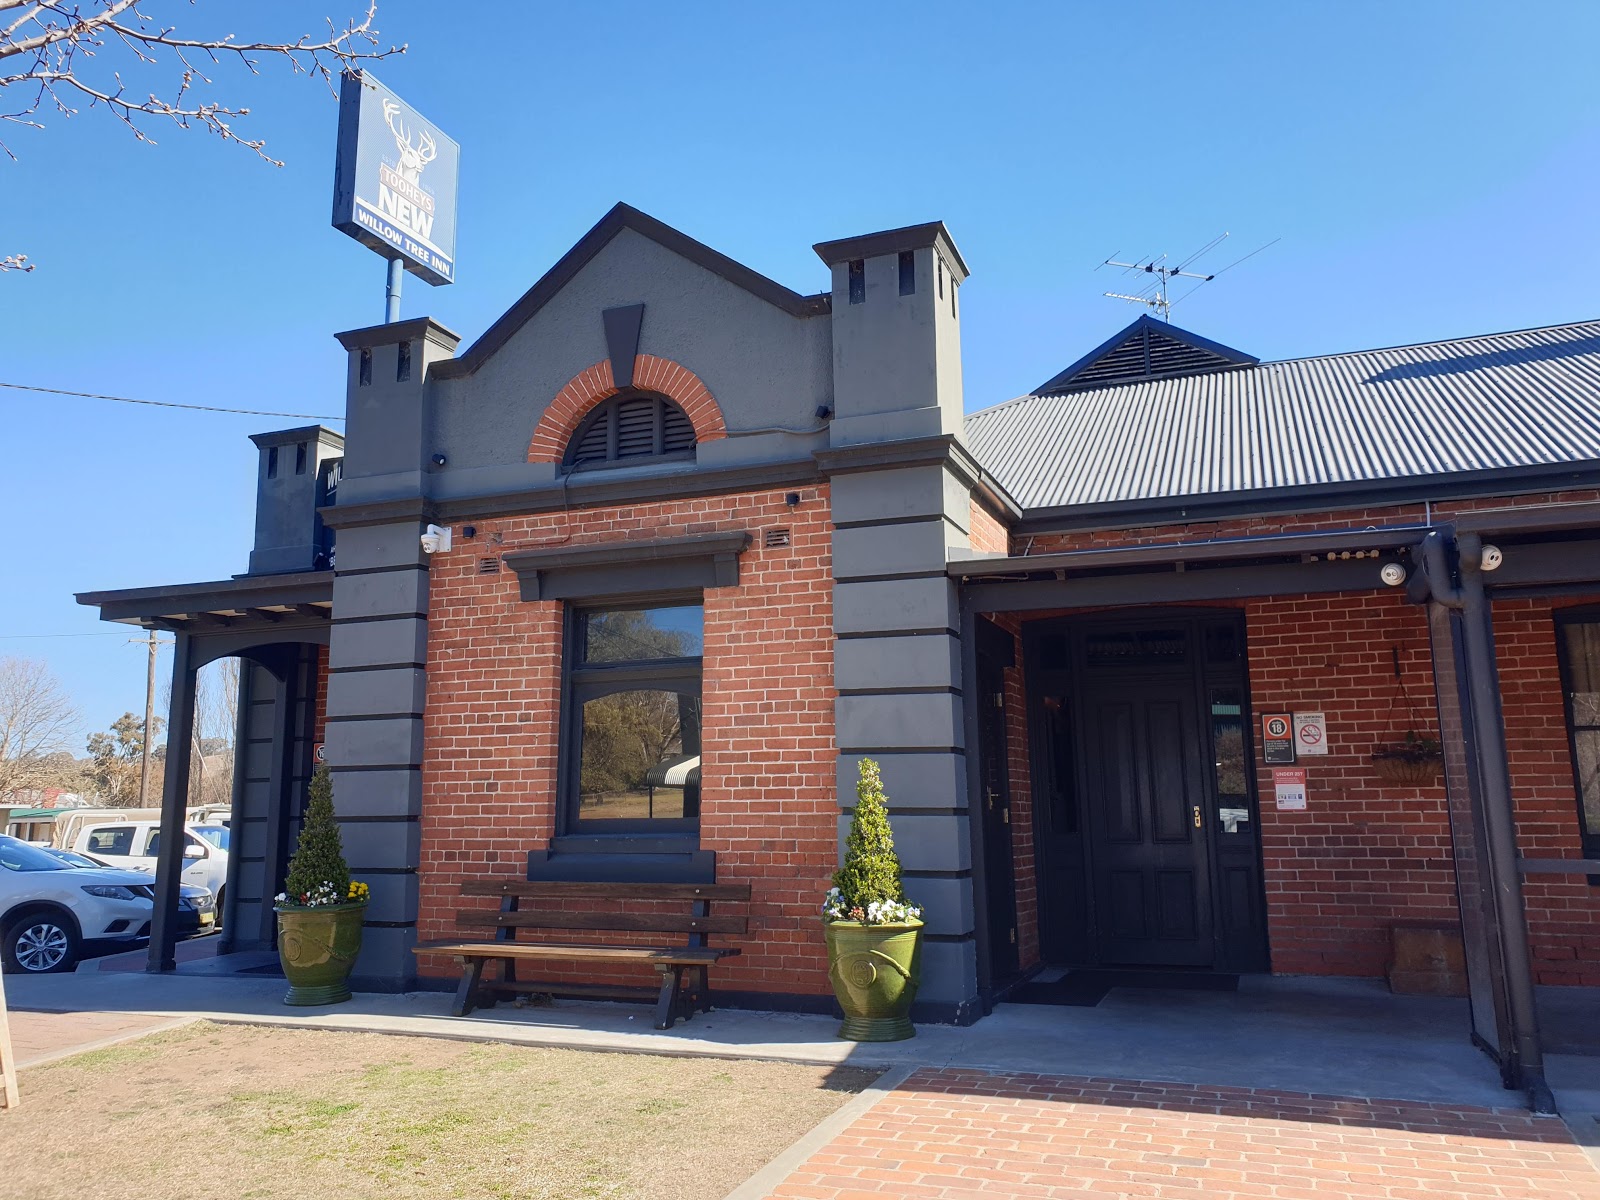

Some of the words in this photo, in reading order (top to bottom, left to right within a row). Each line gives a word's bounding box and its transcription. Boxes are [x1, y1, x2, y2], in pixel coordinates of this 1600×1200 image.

[378, 182, 434, 240] NEW
[385, 170, 432, 211] TOOHEYS
[358, 210, 402, 246] WILLOW
[404, 239, 430, 262] TREE
[431, 255, 450, 276] INN
[1271, 724, 1283, 733] 18
